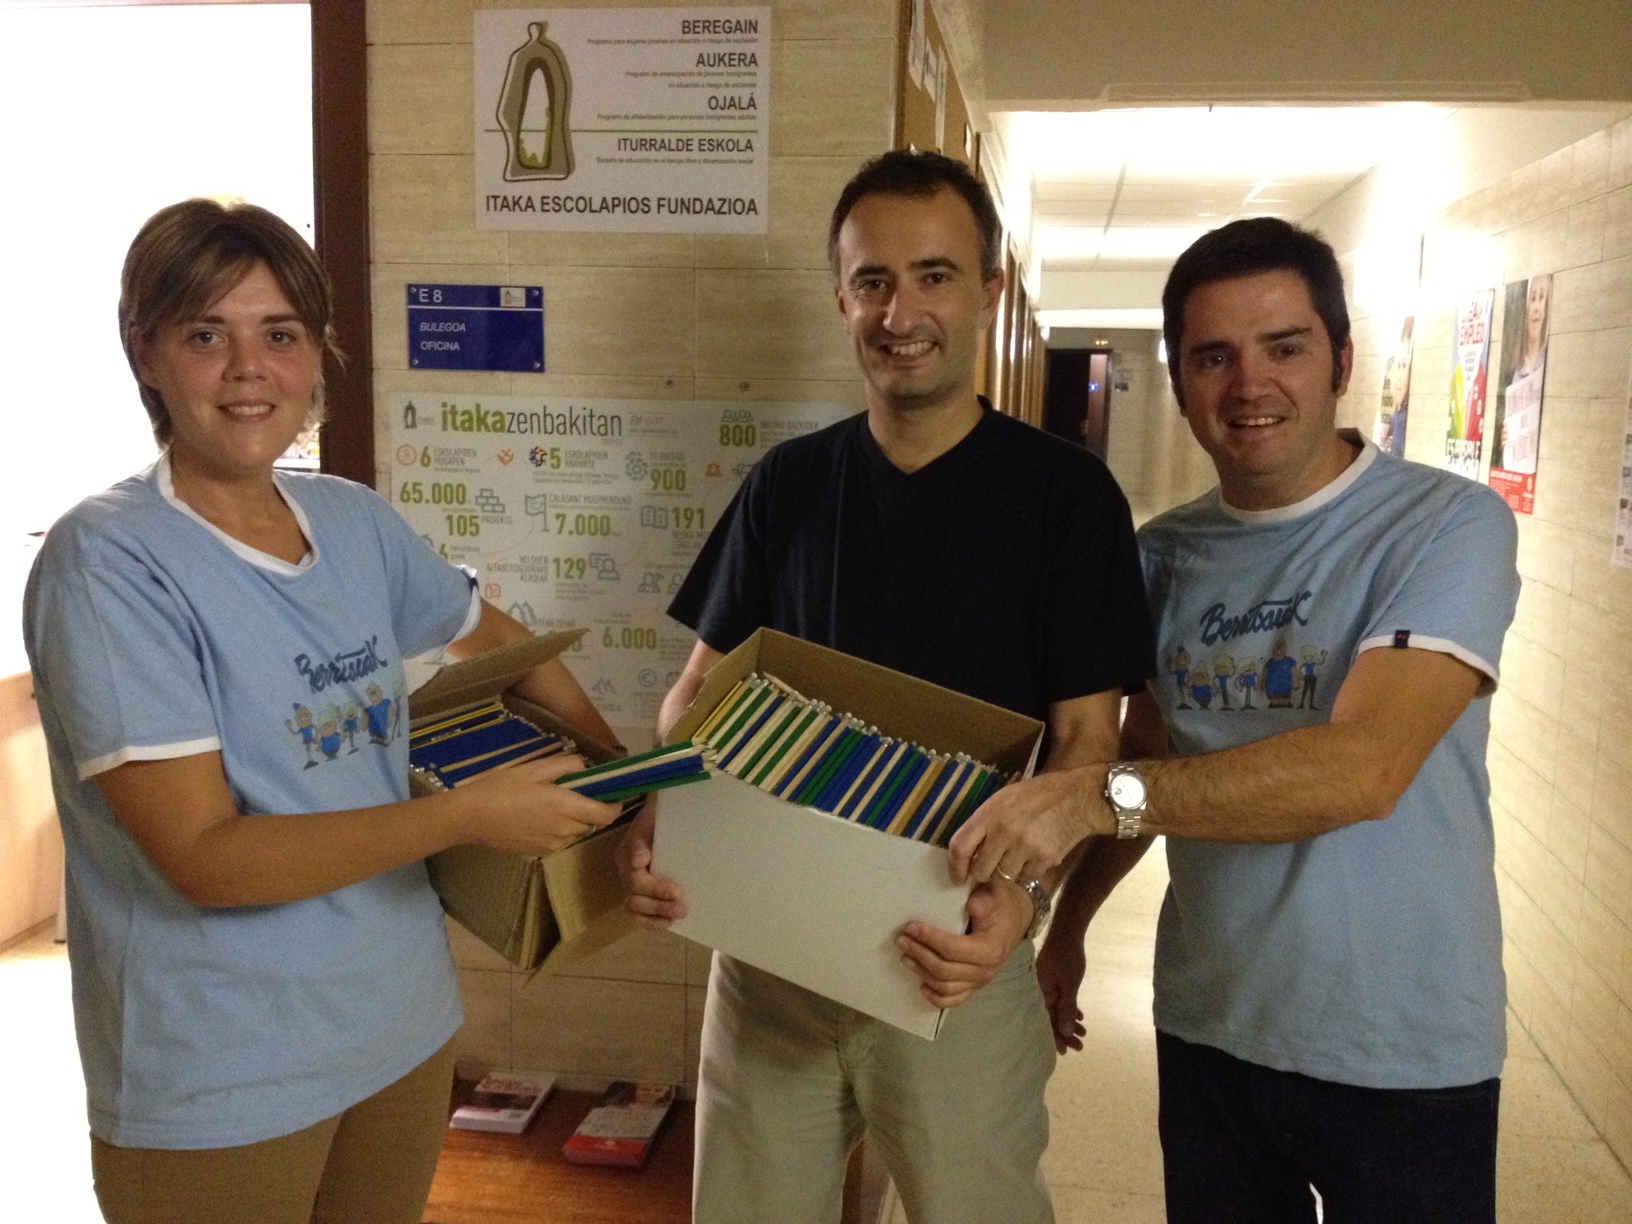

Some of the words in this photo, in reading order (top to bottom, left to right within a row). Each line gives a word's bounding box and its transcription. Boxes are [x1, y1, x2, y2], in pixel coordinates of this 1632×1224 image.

[682, 20, 758, 34] BEREGAIN
[696, 53, 758, 67] AUKERA
[708, 92, 757, 110] OJALÁ
[618, 138, 694, 152] ITURRALDE
[698, 139, 753, 152] ESKOLA
[486, 195, 536, 212] ITAKA
[540, 196, 651, 214] ESCOLAPIOS
[657, 197, 758, 215] FUNDAZIOA
[419, 289, 429, 302] E
[433, 290, 442, 303] 8
[419, 322, 466, 332] BULEGOA
[421, 341, 460, 350] OFICINA
[720, 424, 756, 447] 800
[420, 446, 431, 468] 6
[550, 448, 561, 469] 5
[650, 469, 686, 491] 900
[400, 482, 466, 505] 65.000
[446, 514, 479, 536] 105
[555, 513, 611, 537] 7.000
[672, 506, 704, 529] 191
[553, 558, 587, 579] 129
[602, 626, 657, 650] 6.000
